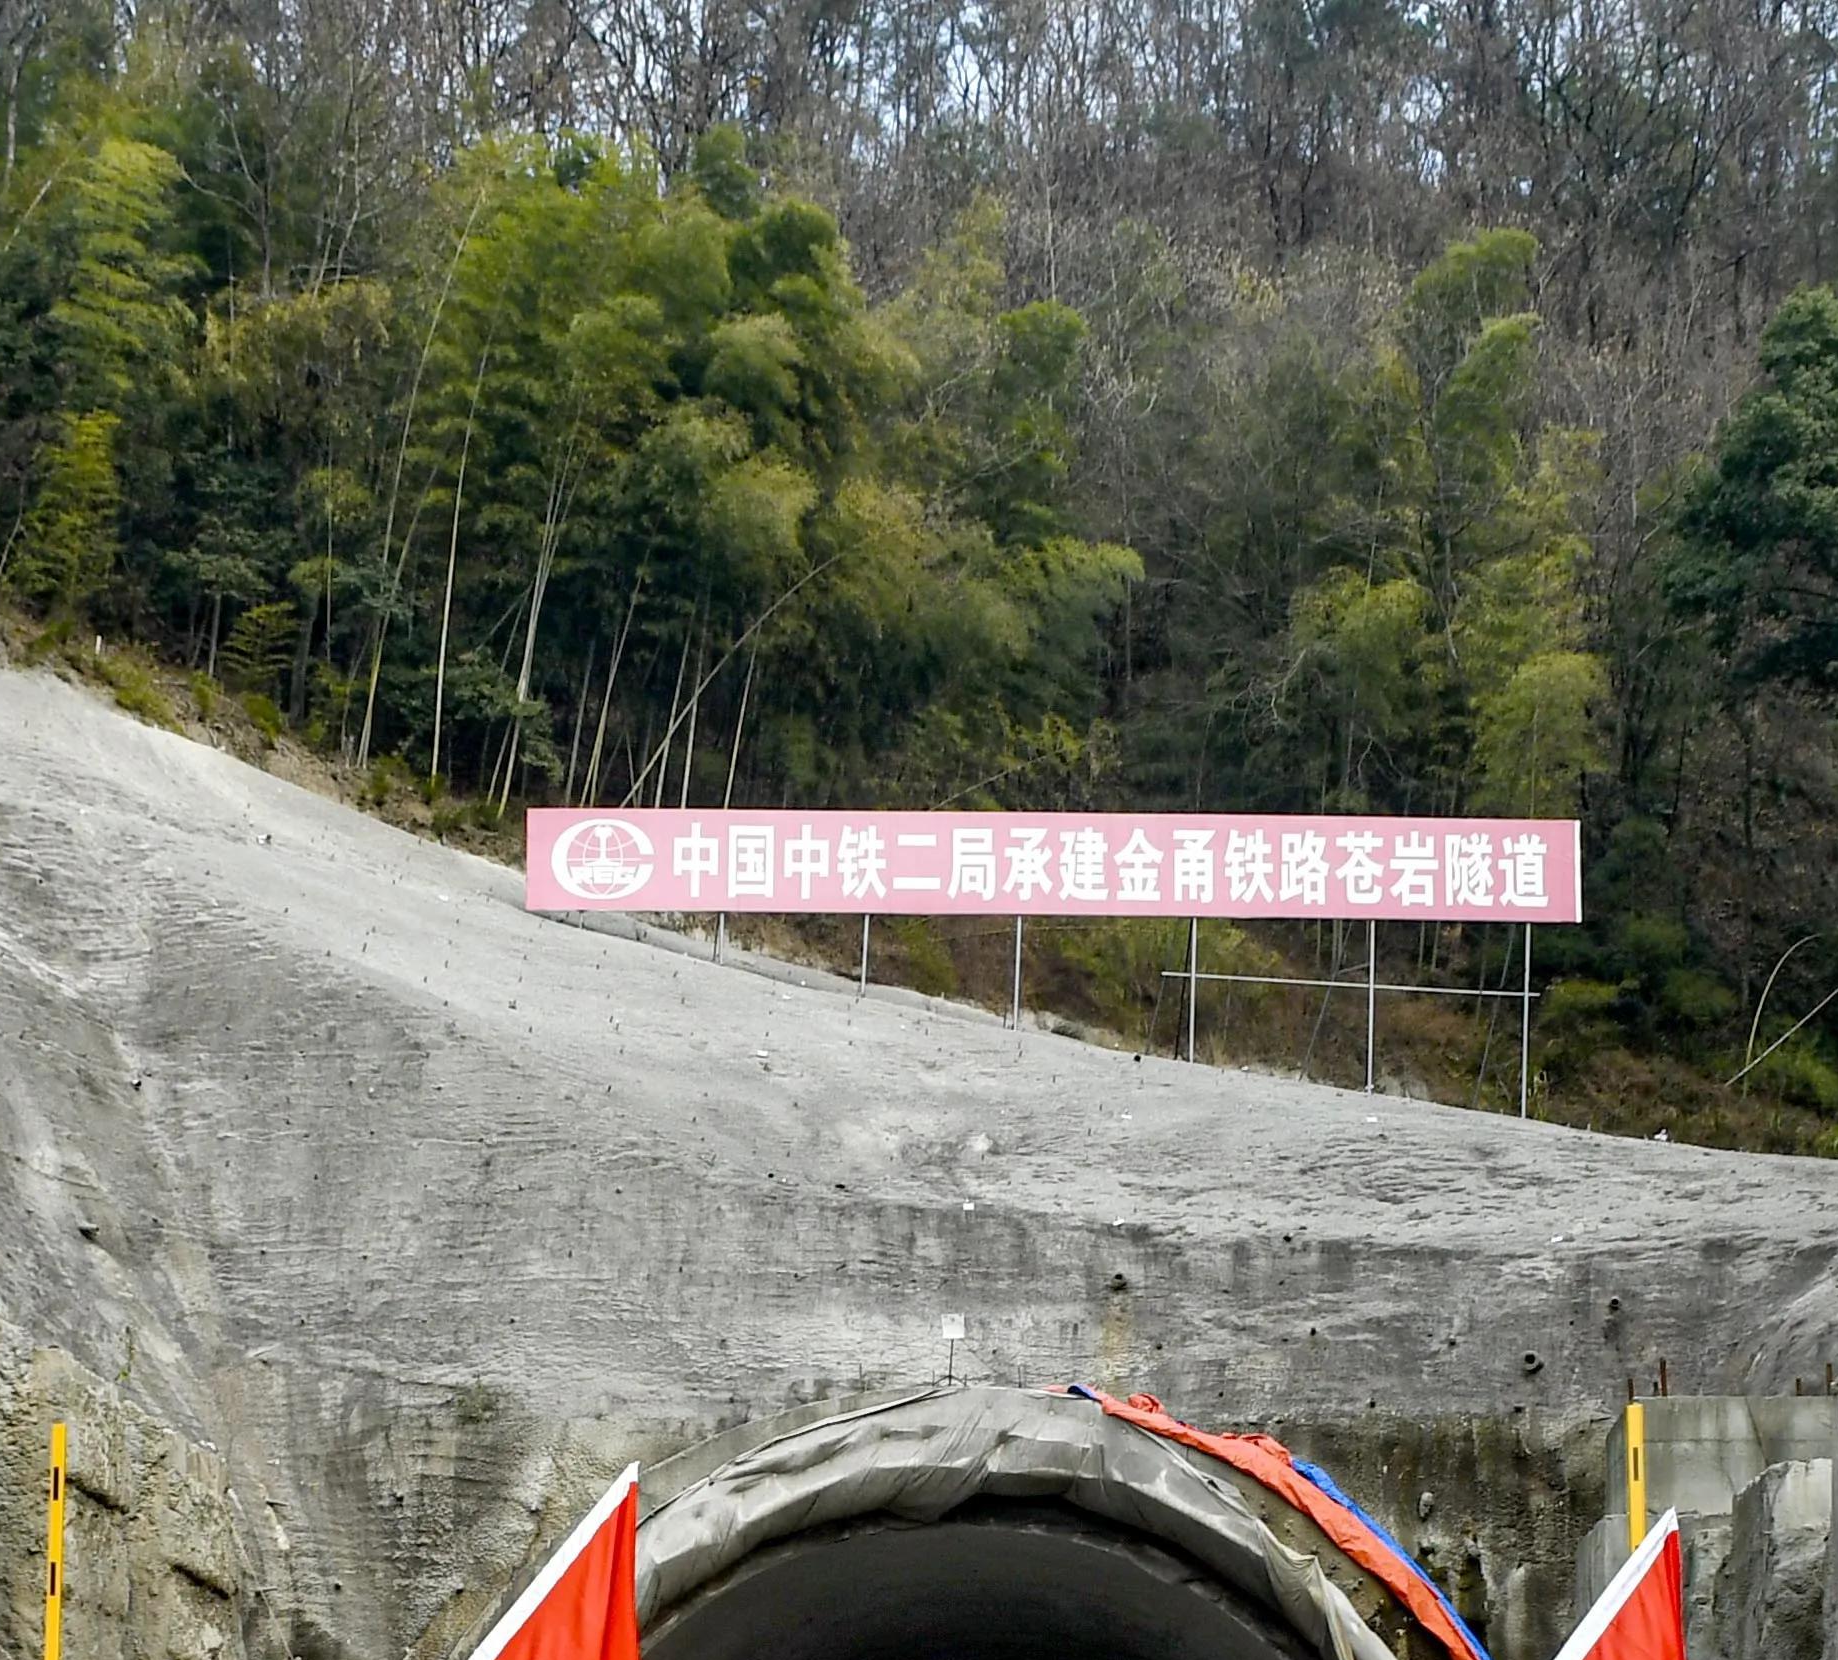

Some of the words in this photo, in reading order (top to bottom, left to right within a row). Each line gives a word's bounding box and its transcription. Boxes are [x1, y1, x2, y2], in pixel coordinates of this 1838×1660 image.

[673, 821, 1549, 908] 中国中铁二局承建金甬铁路苍岩隧道
